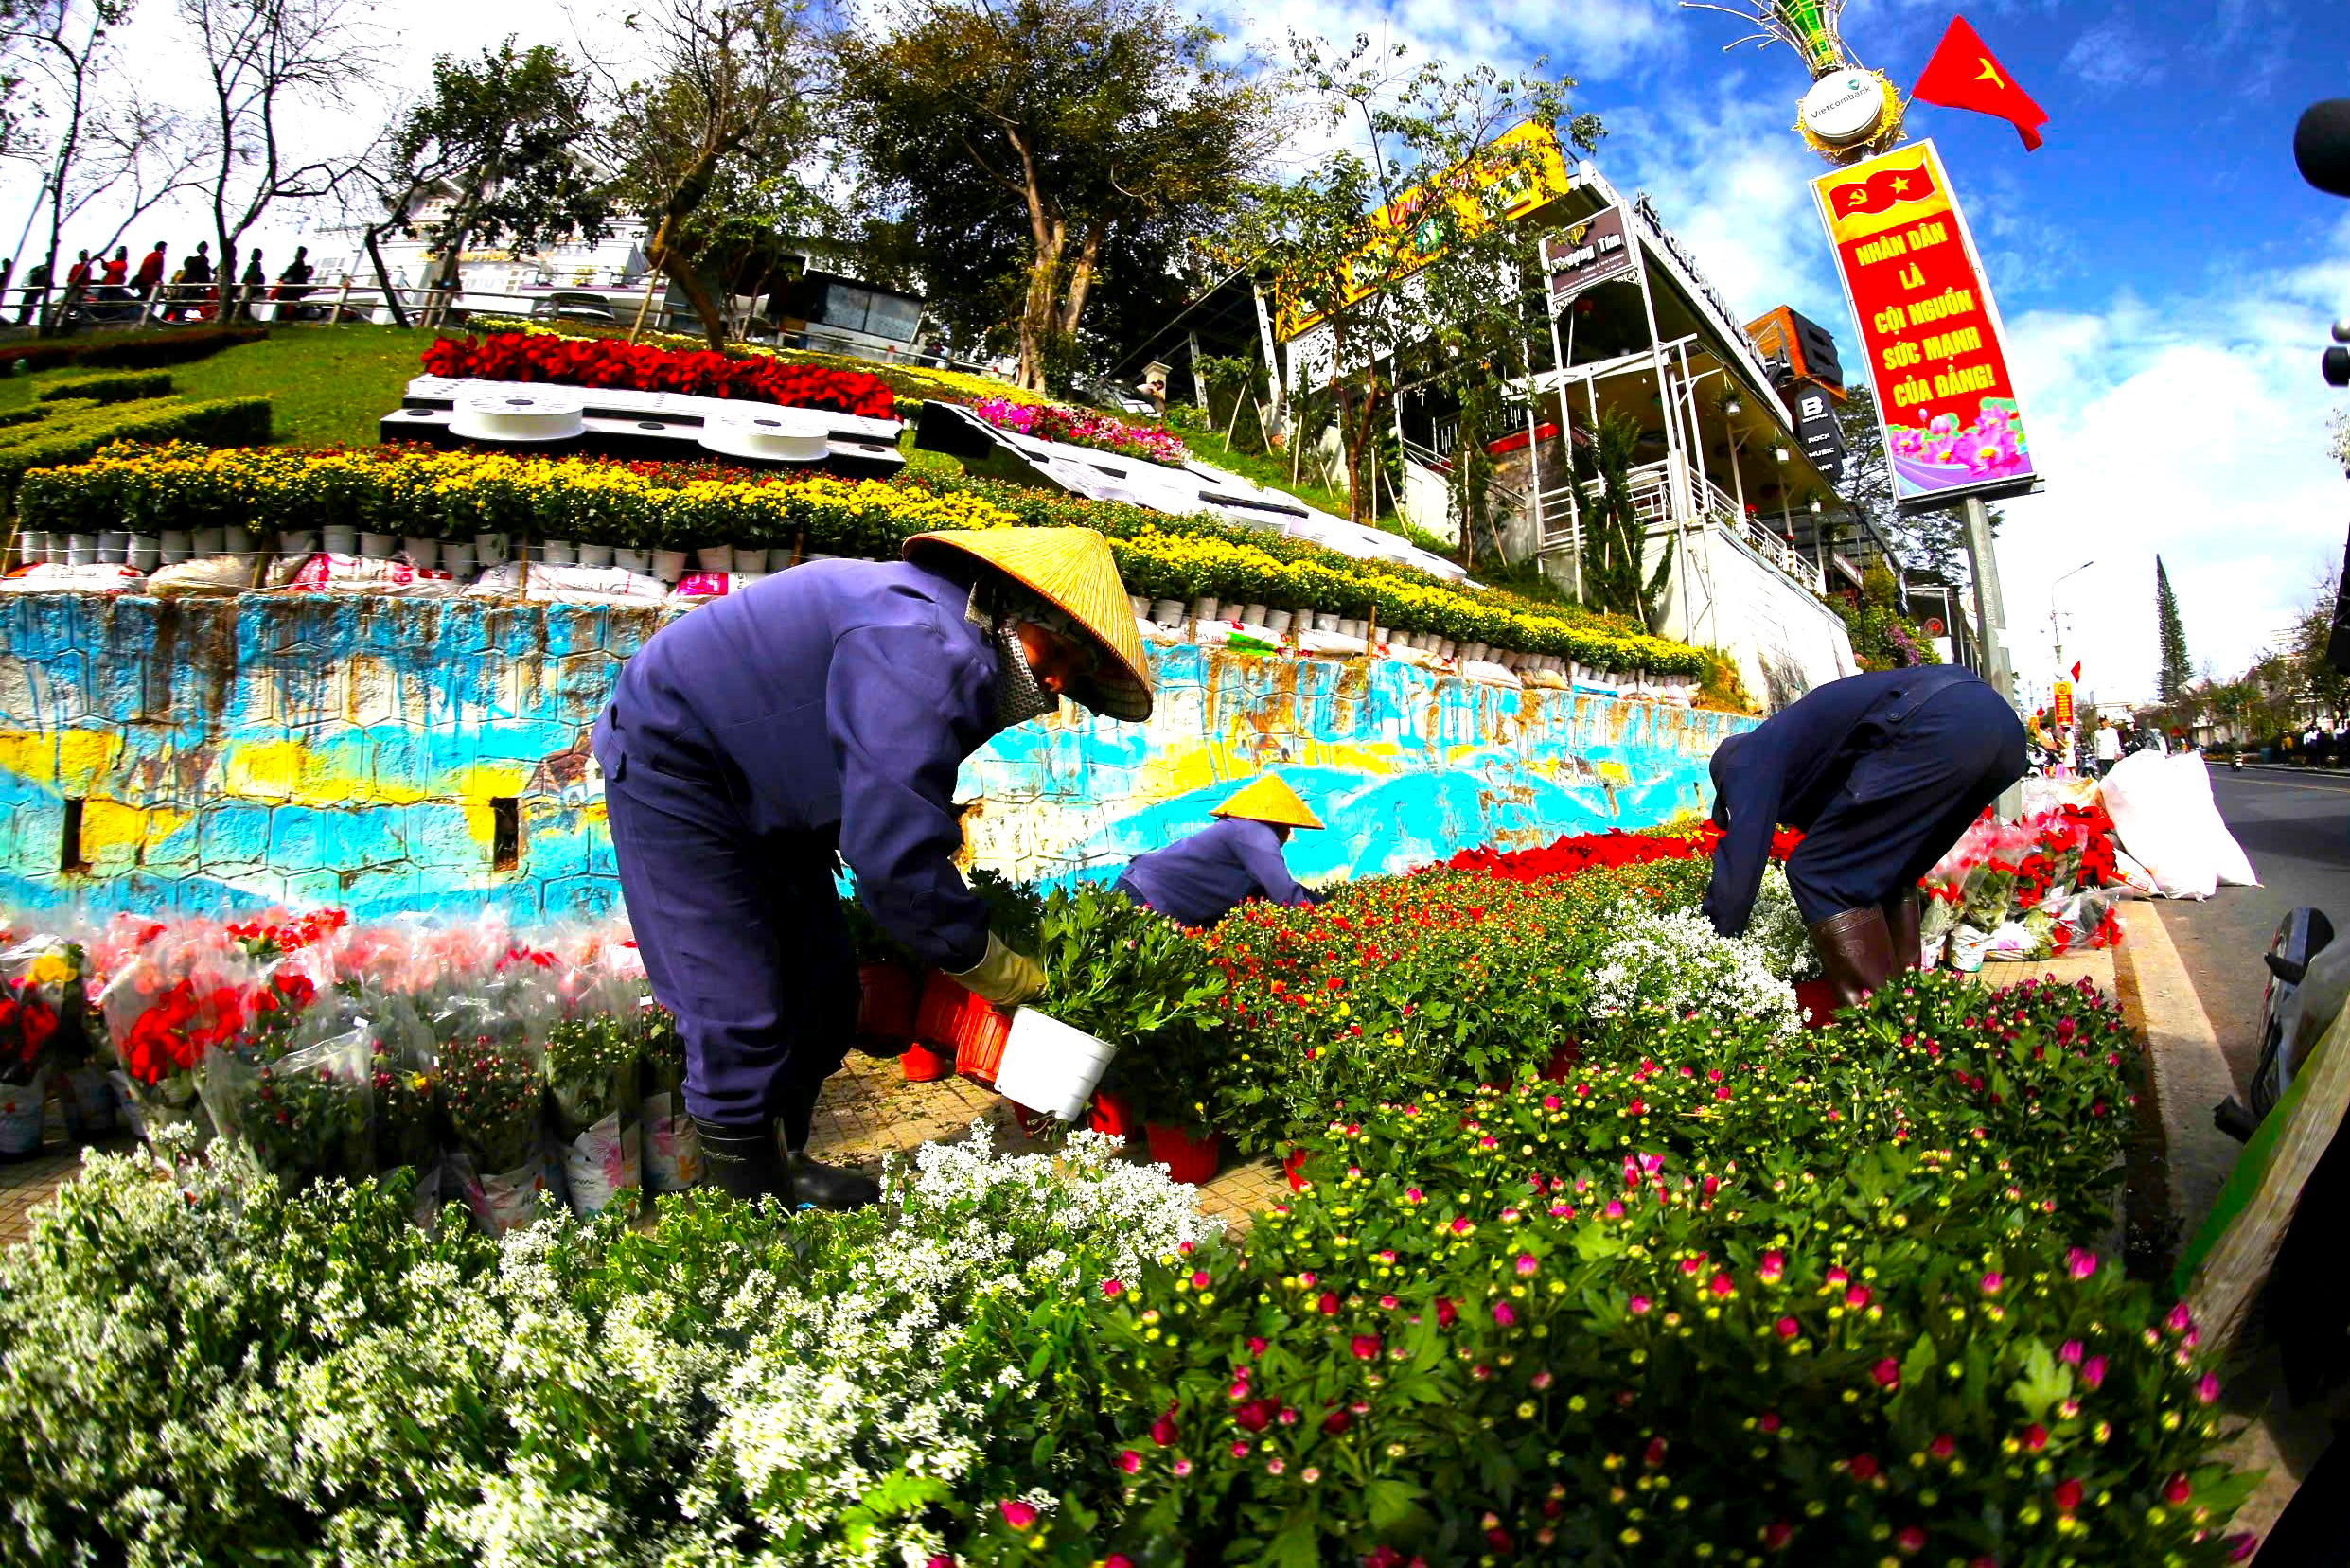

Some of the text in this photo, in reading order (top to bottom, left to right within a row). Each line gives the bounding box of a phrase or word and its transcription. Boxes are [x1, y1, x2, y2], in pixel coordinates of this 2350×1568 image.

[1810, 85, 1871, 118] Vietcombank
[1855, 221, 1948, 267] NHÂN DÂN
[1899, 261, 1926, 290] LÀ
[1874, 286, 1974, 335] CỘI NGUỒN
[1882, 326, 1982, 370] SỨC MẠNH
[1893, 363, 1996, 408] CỦA ĐẢNG!
[1801, 396, 1823, 417] B
[1808, 432, 1830, 444] ROCK
[1808, 448, 1834, 458] MUSIC
